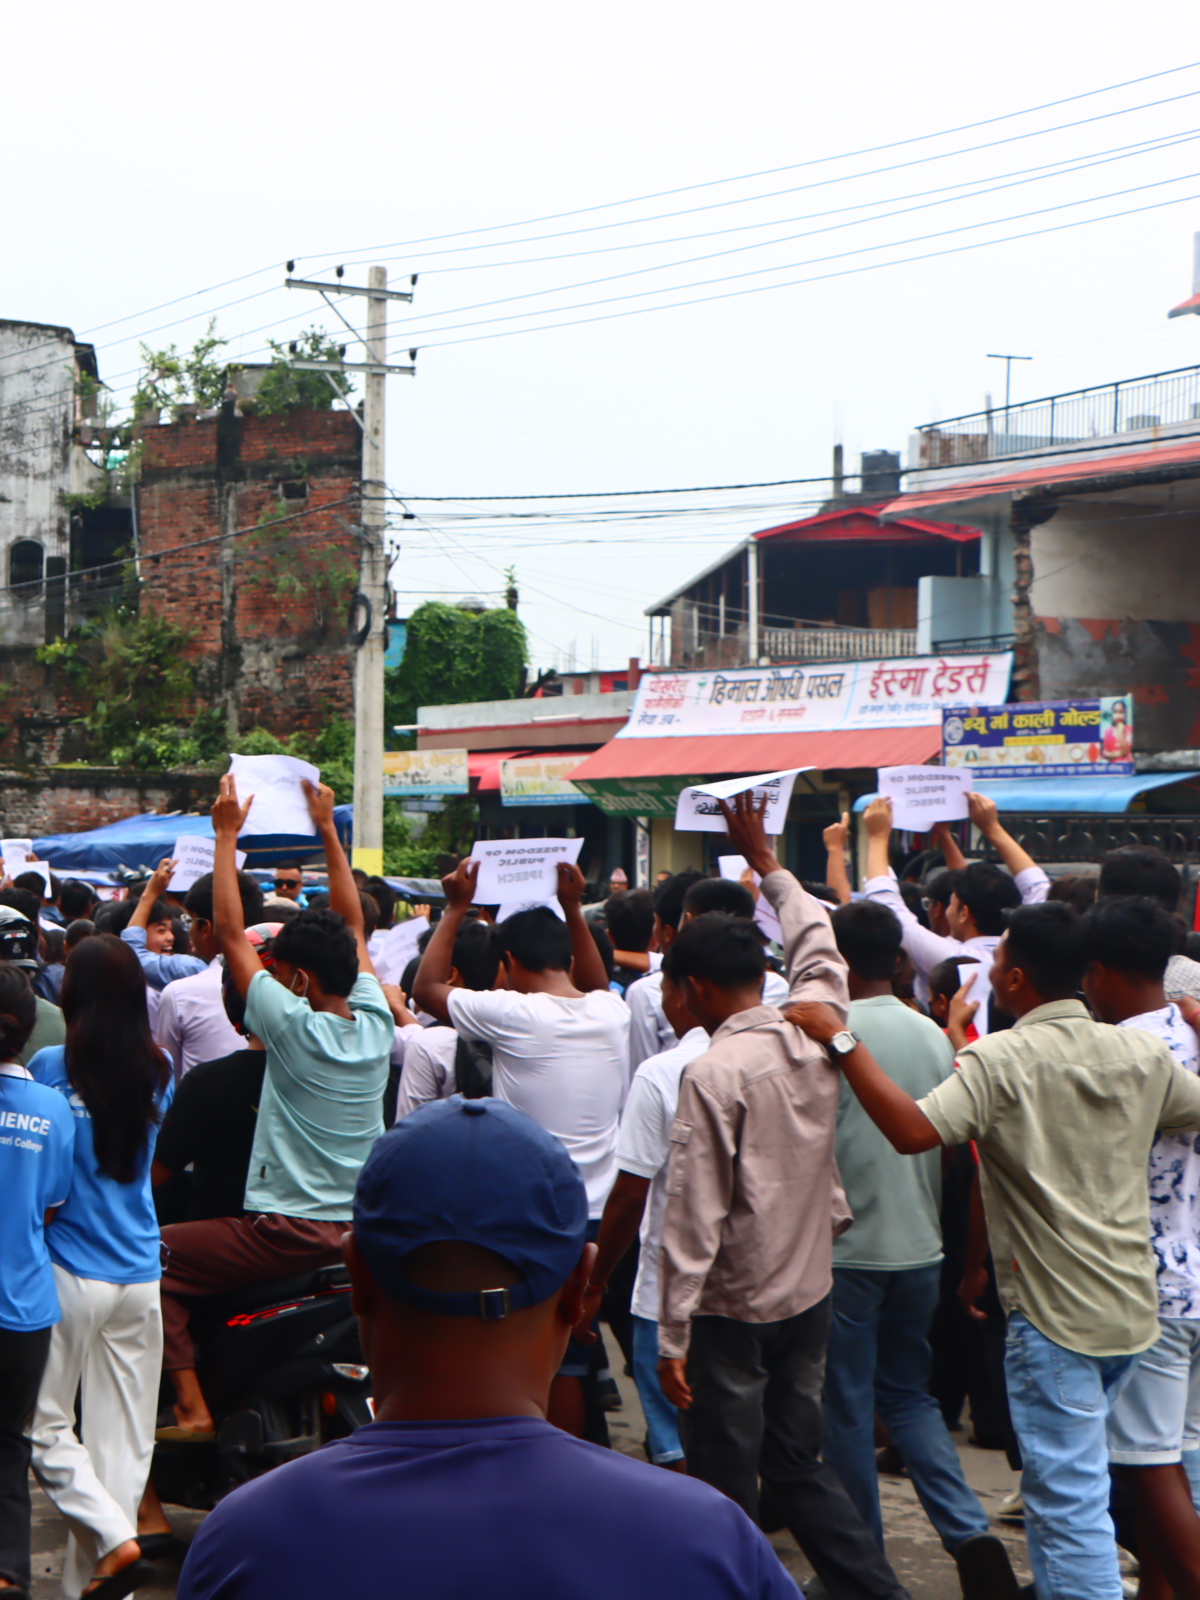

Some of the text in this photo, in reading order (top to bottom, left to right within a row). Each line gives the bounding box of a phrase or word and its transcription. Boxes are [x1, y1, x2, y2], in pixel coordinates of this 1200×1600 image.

[806, 673, 846, 699] पसल
[1013, 709, 1055, 729] काली
[14, 1137, 43, 1154] College
